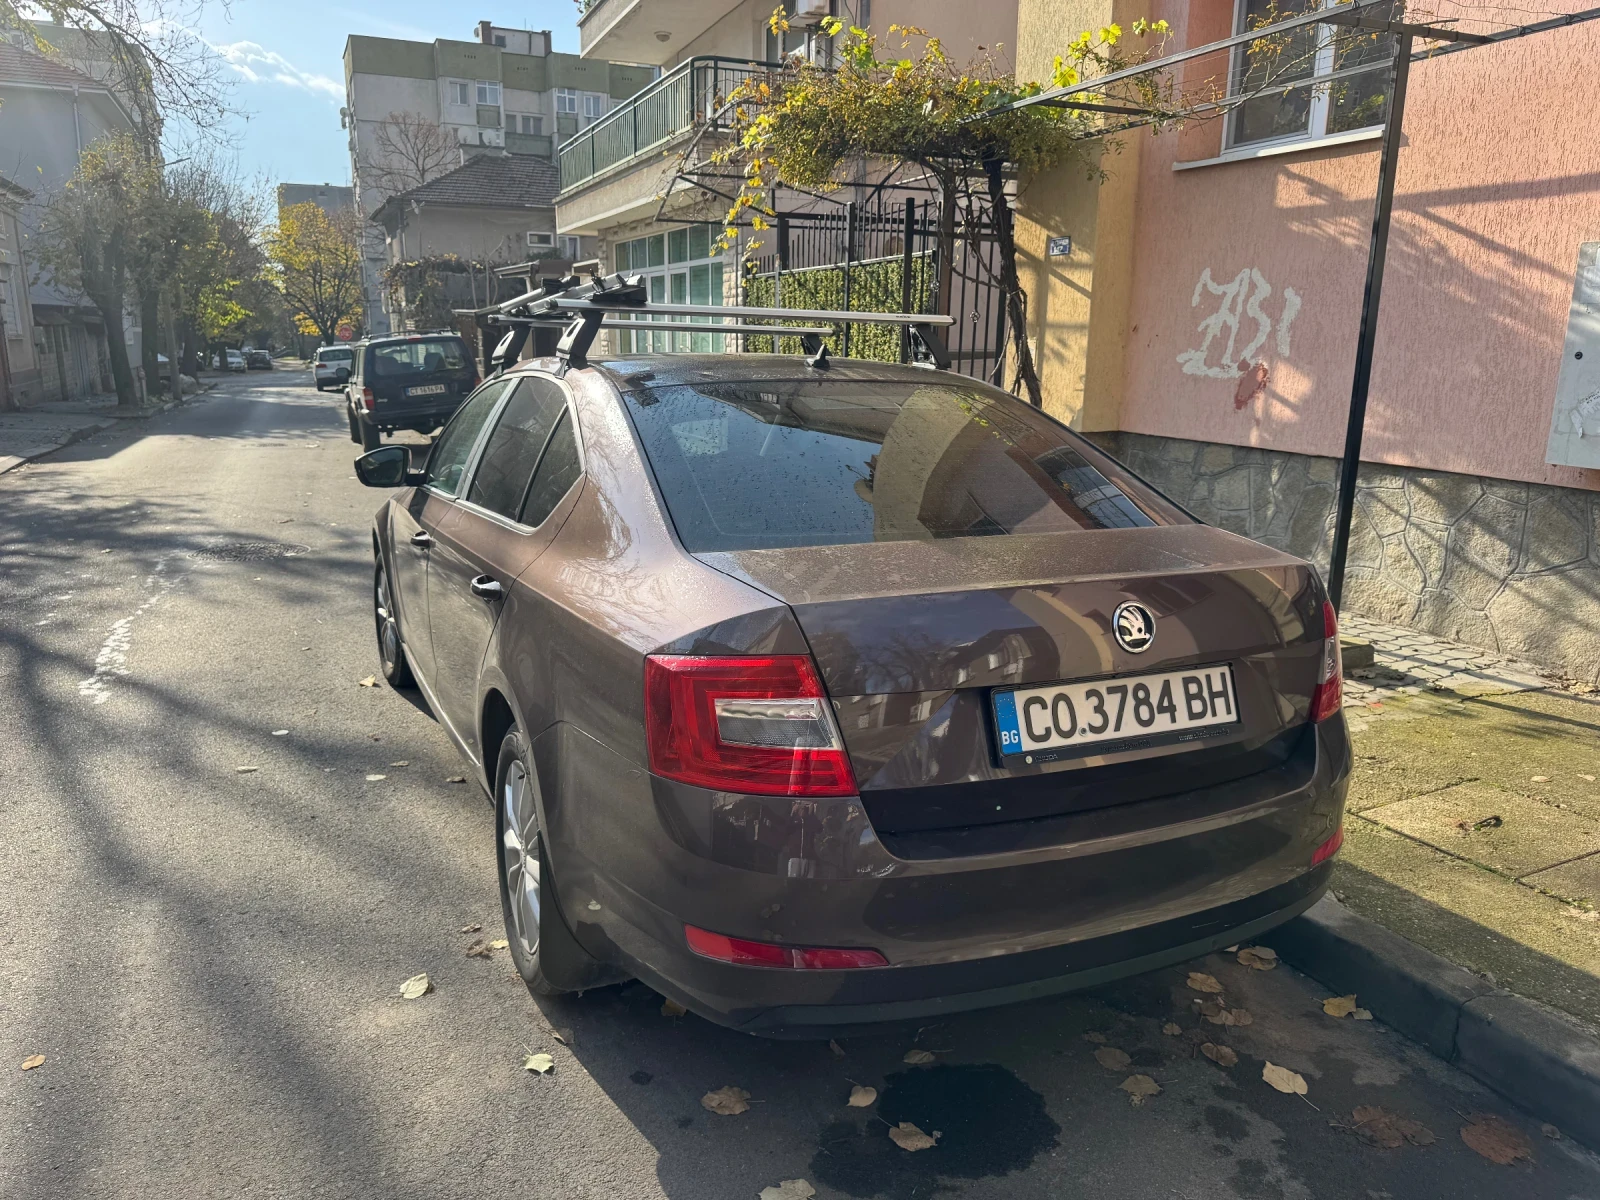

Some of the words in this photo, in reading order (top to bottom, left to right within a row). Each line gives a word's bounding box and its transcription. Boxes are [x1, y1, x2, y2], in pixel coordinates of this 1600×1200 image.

[410, 387, 419, 395] CT
[1023, 692, 1077, 743] CO
[1085, 679, 1177, 734] 3784
[1181, 672, 1232, 721] BH
[1001, 730, 1019, 745] BG
